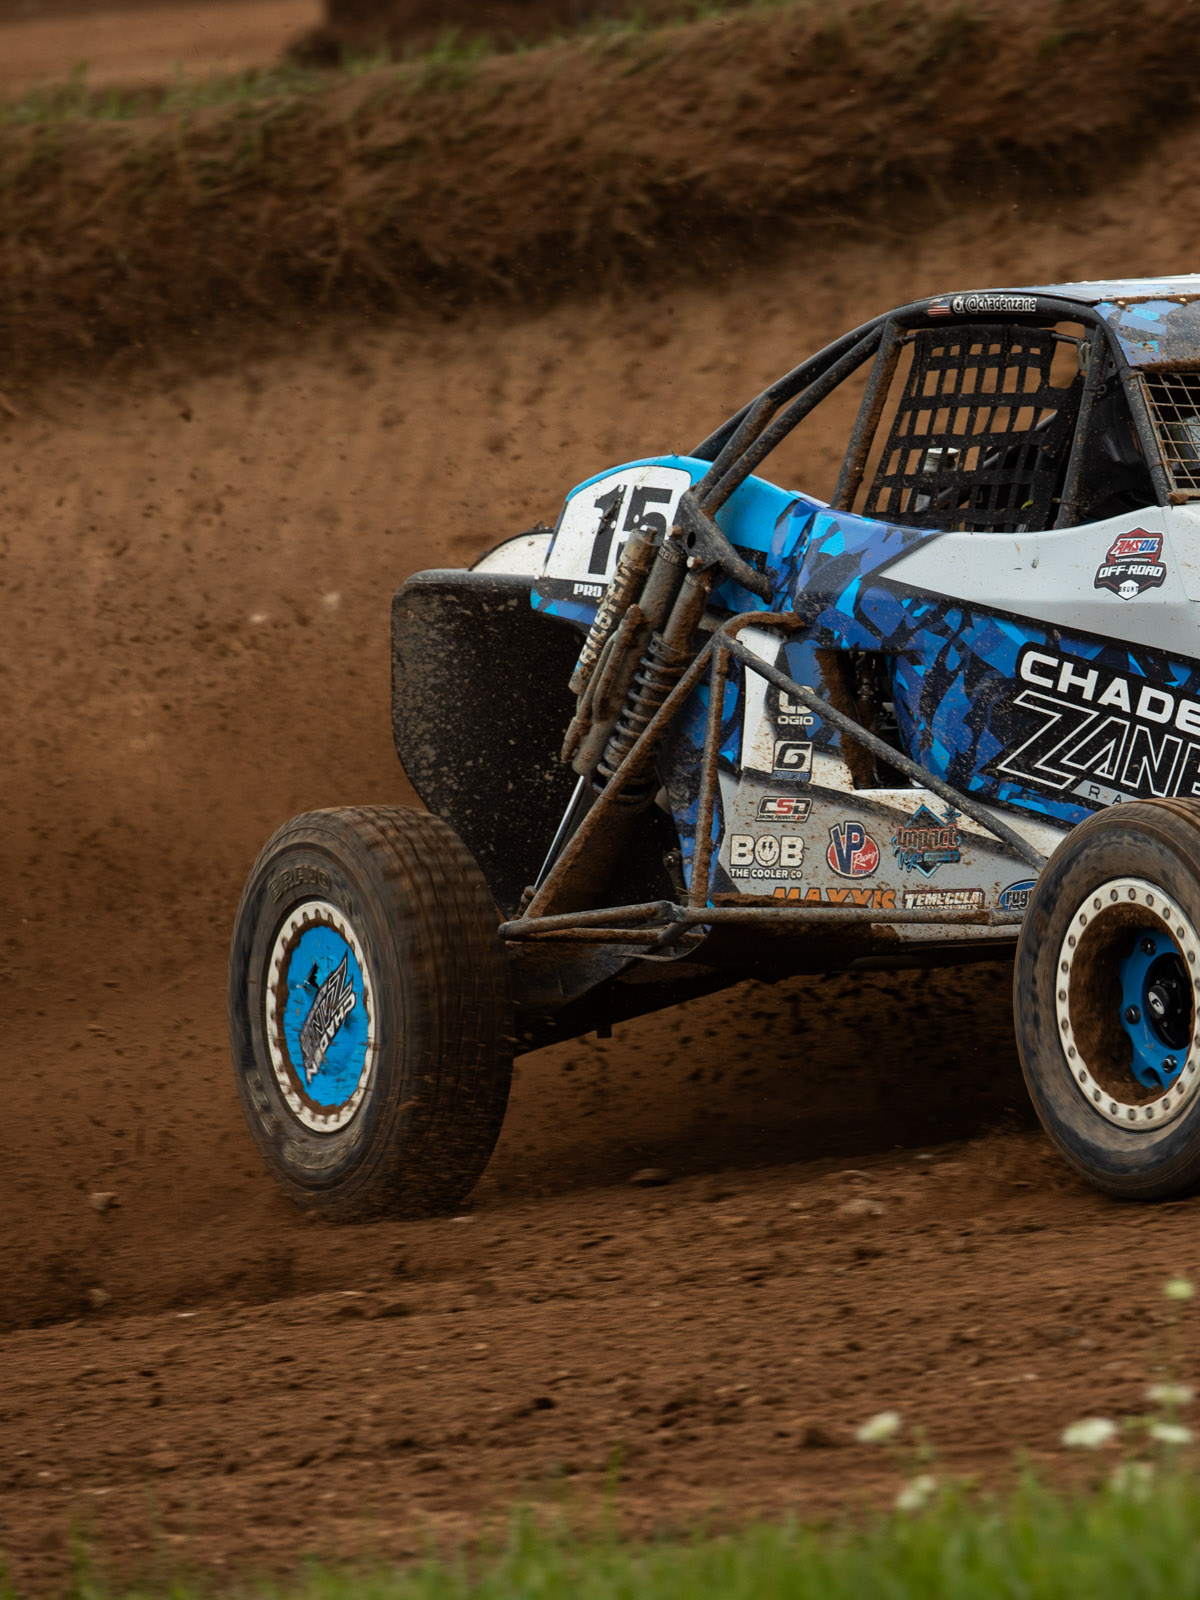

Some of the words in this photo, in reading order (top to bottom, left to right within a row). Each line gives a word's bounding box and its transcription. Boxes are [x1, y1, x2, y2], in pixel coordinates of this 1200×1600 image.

[965, 295, 1038, 312] @chadenzane
[588, 484, 674, 575] 15
[1110, 538, 1160, 557] AMSOIL
[1098, 564, 1164, 579] OFF-ROAD
[573, 583, 603, 597] PRO
[777, 715, 814, 726] OGIO
[730, 833, 804, 867] BOB
[829, 821, 867, 875] VP
[729, 868, 750, 878] THE
[751, 868, 789, 878] COOLER
